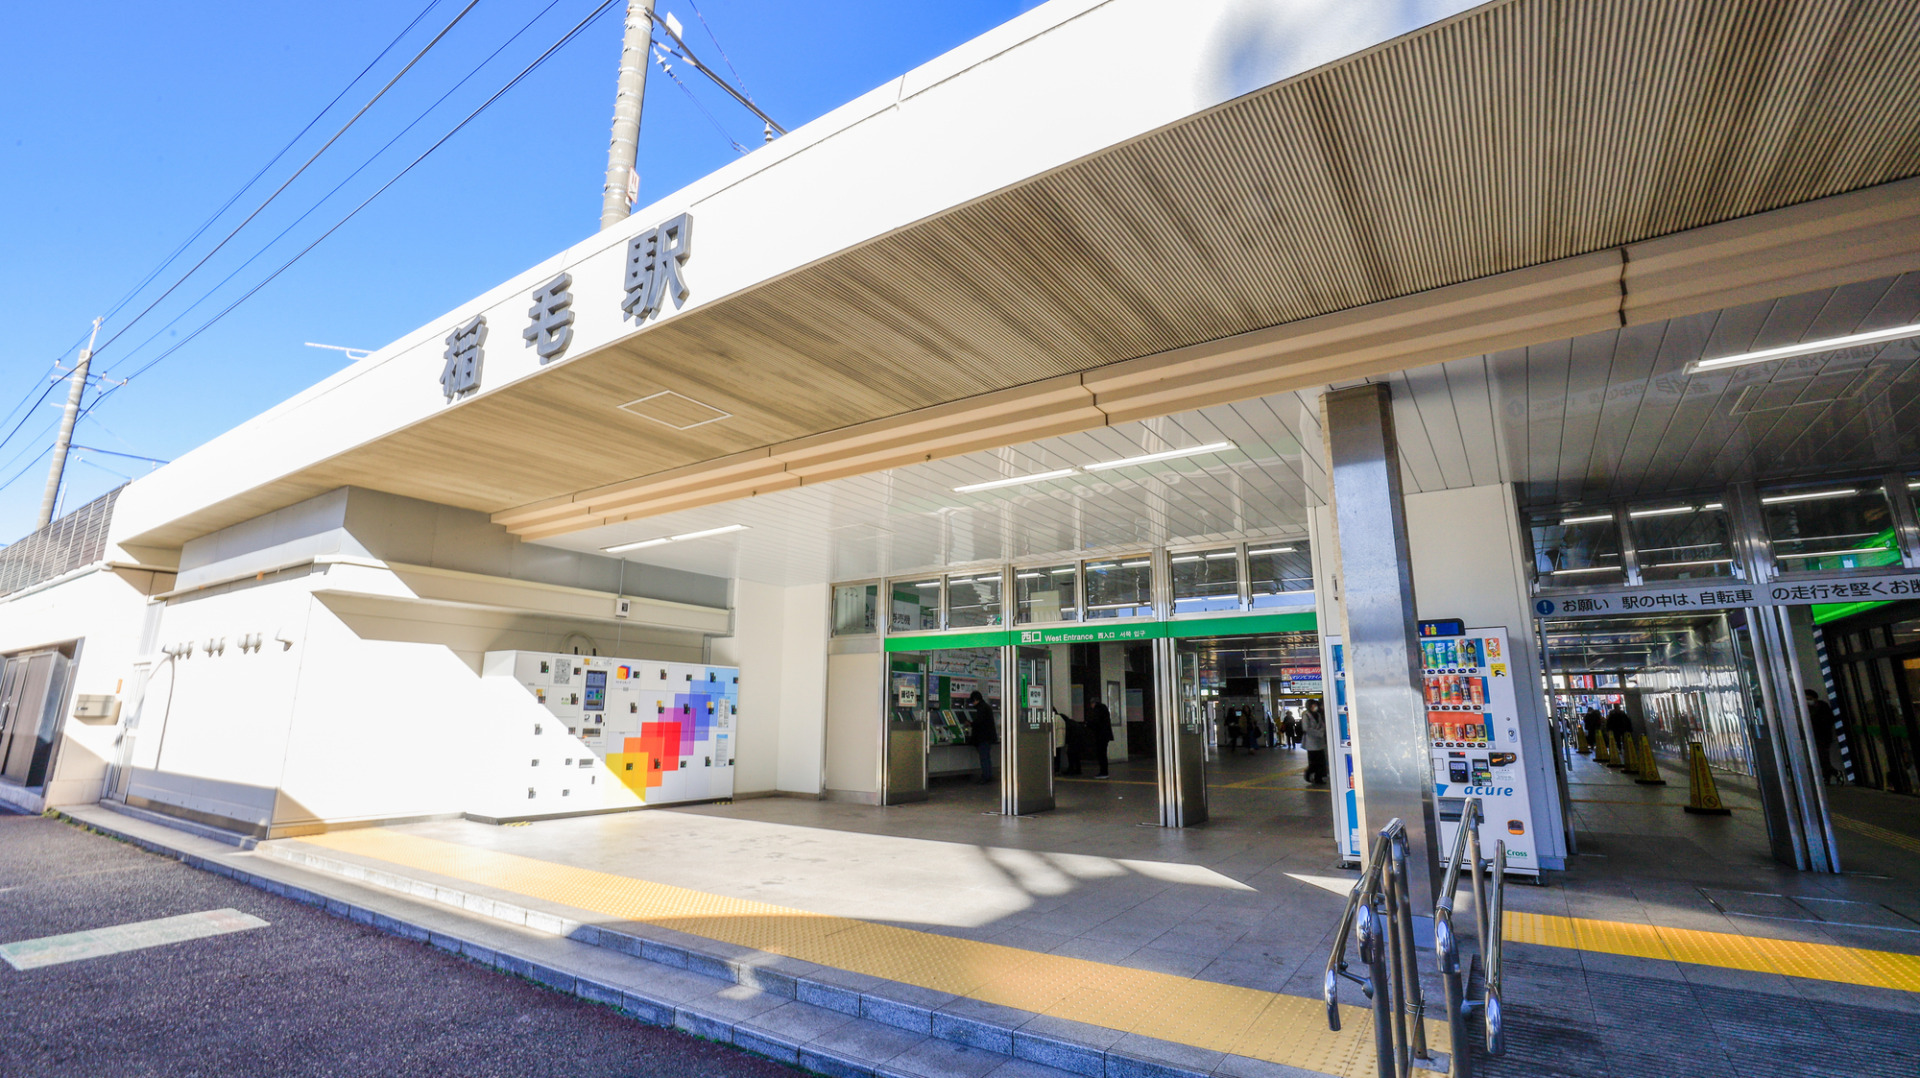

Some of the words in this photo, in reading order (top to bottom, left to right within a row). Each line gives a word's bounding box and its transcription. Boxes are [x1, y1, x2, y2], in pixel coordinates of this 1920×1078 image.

[439, 212, 694, 405] 稲毛駅
[1562, 598, 1609, 612] お願い
[1021, 631, 1042, 643] 西口
[1045, 634, 1062, 642] West
[1063, 633, 1094, 641] Entrance
[1464, 786, 1514, 797] acure
[1507, 849, 1528, 857] Cross
